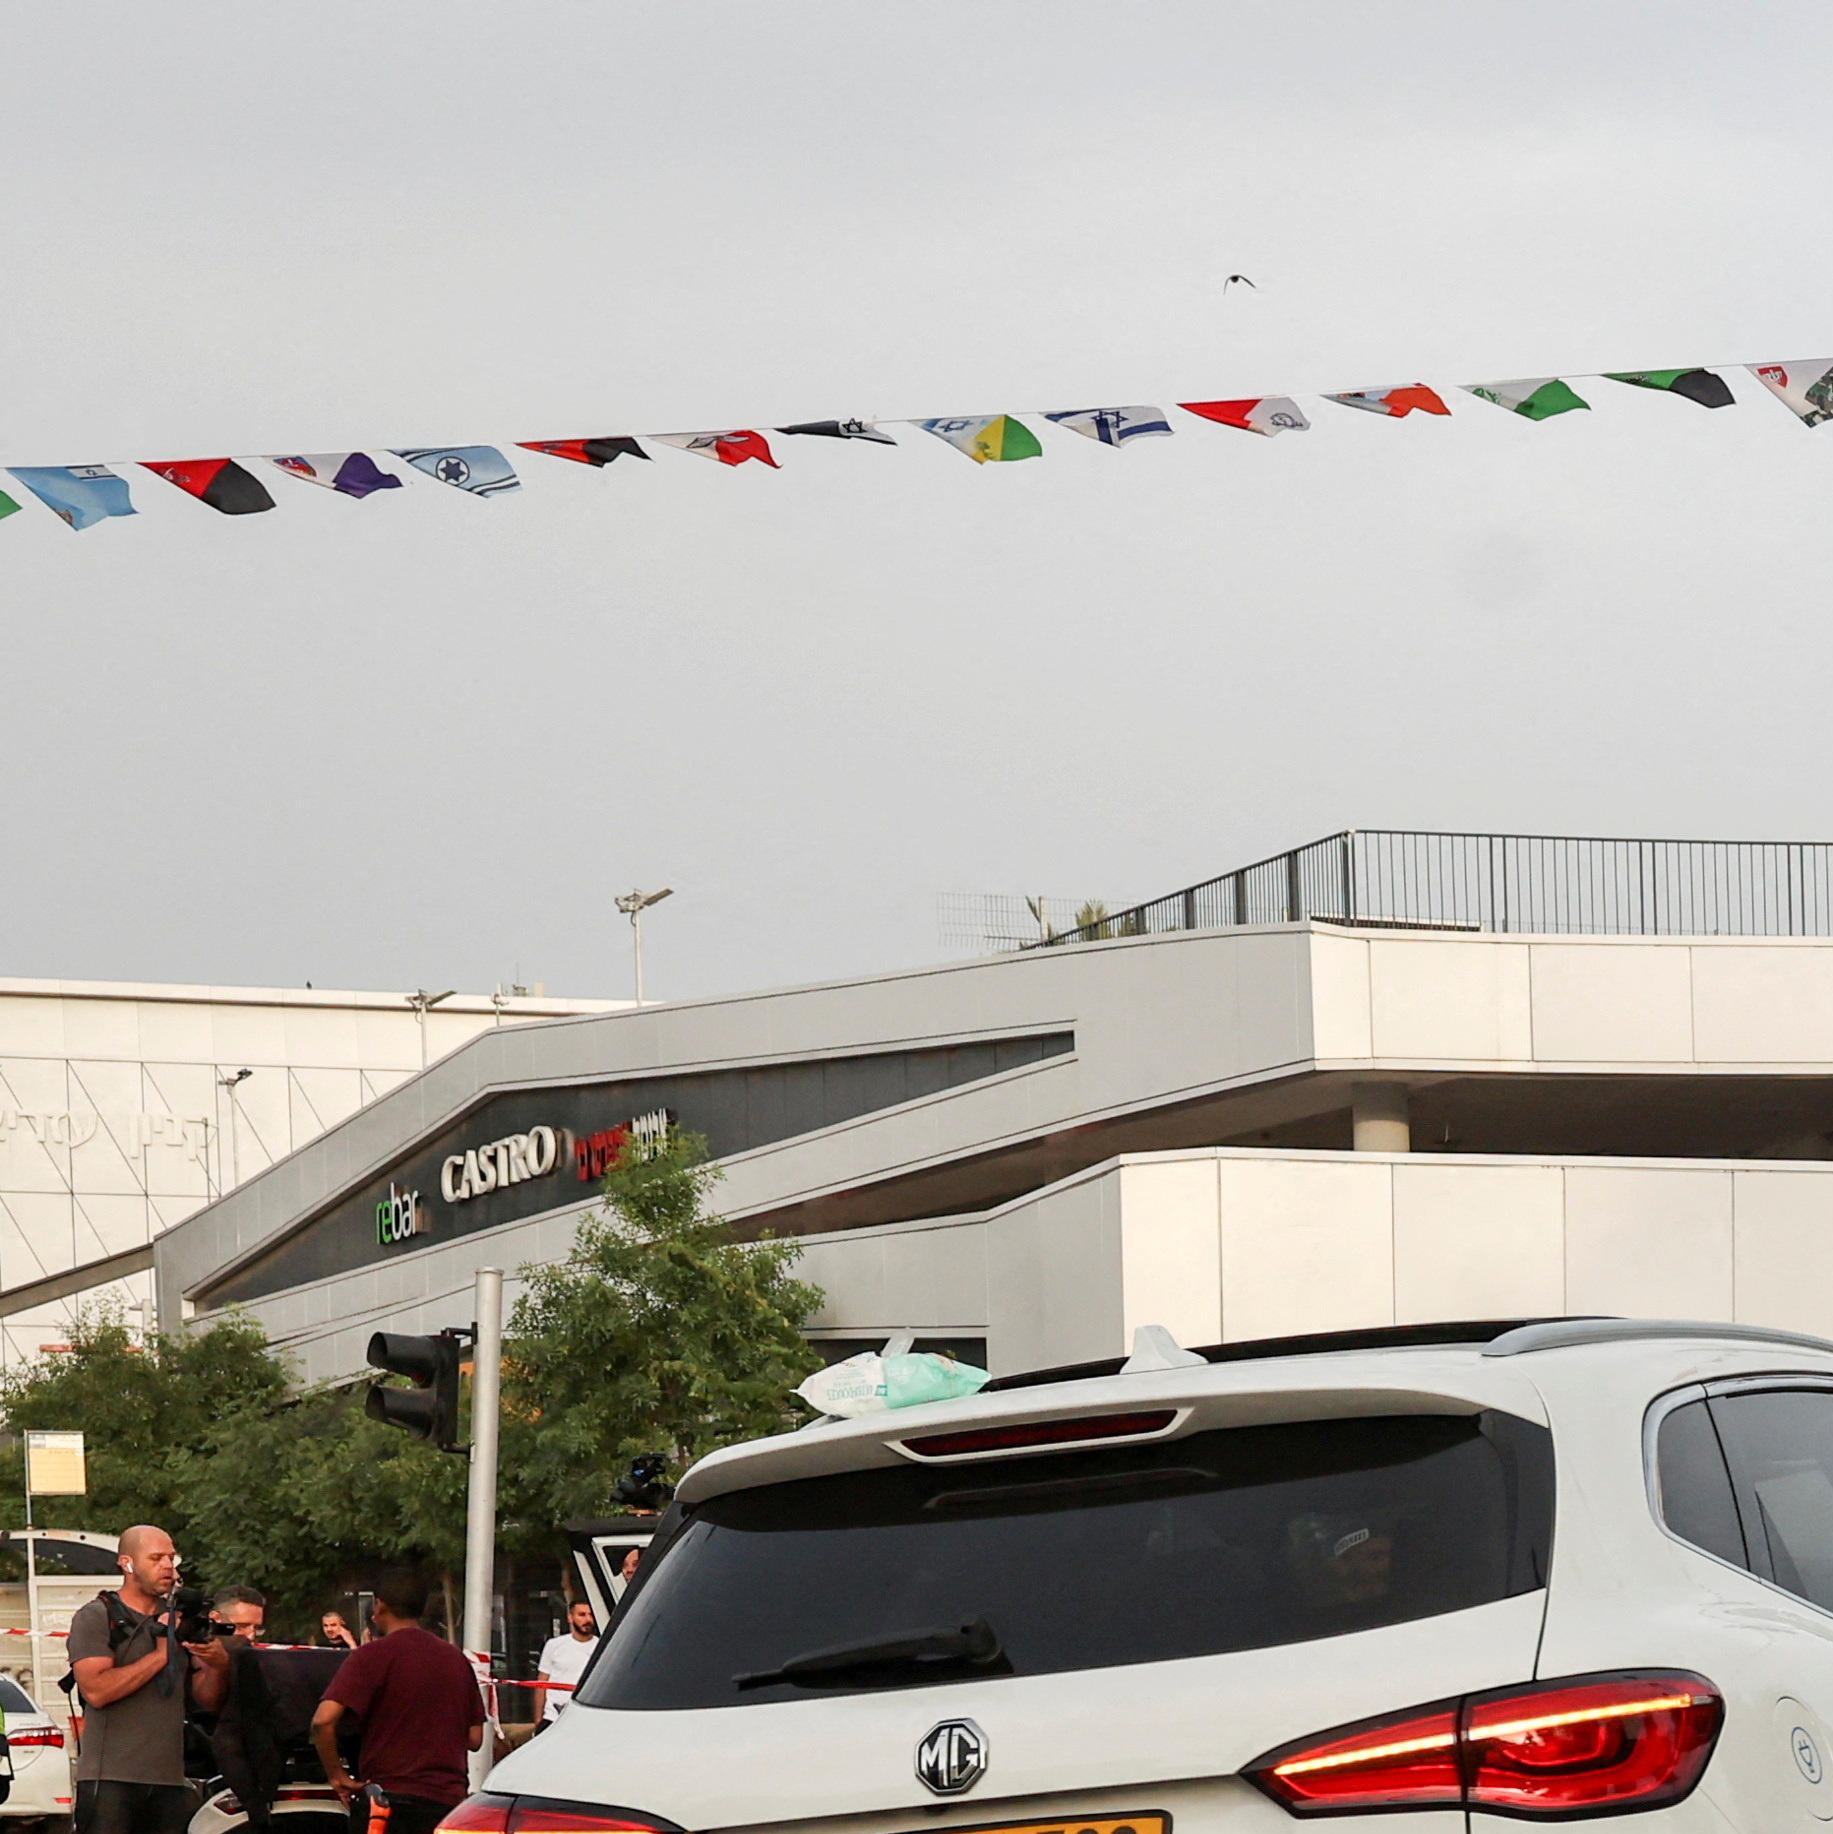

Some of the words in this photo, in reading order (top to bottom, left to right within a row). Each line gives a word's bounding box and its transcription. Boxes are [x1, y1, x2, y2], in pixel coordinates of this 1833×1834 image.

[441, 1125, 557, 1203] CASTRO
[376, 1183, 419, 1245] rebar
[919, 1727, 979, 1788] MG
